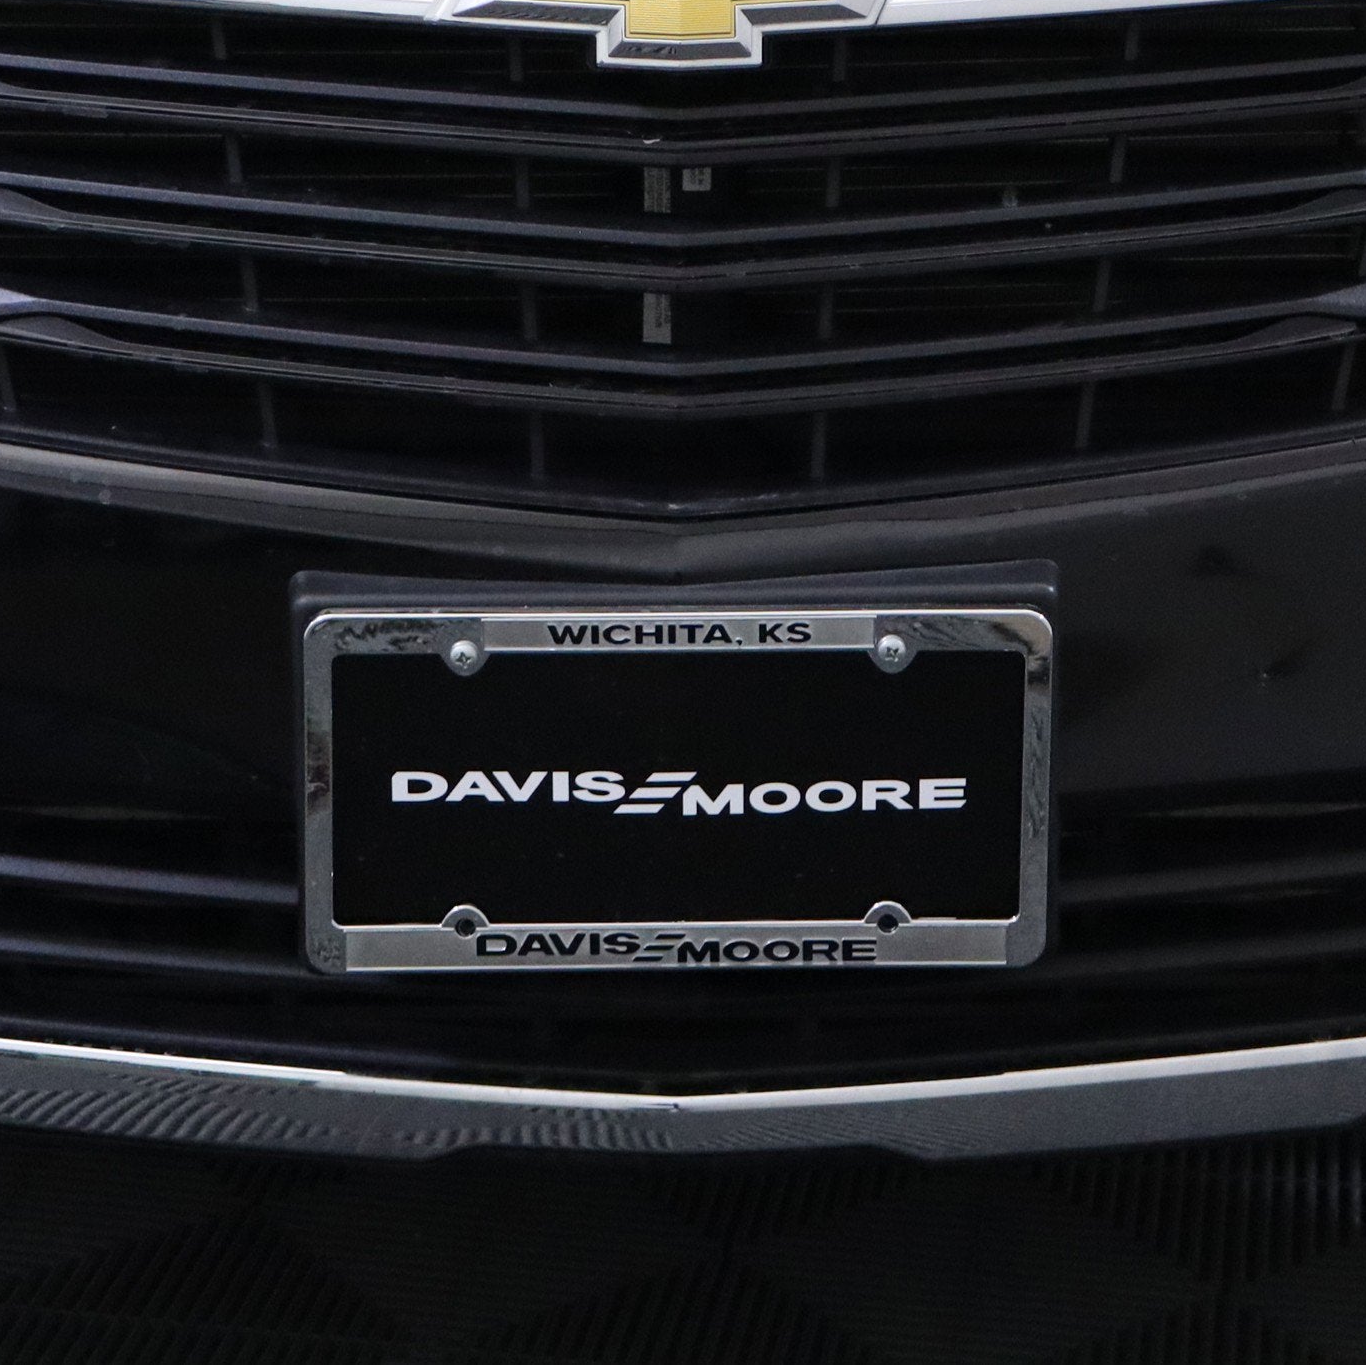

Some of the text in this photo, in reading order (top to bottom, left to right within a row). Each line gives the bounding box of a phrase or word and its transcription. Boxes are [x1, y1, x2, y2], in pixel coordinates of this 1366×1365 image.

[547, 623, 813, 647] WICHITA, KS
[392, 771, 968, 817] DAVIS MOORE
[476, 933, 879, 965] DAVIS MOORE
